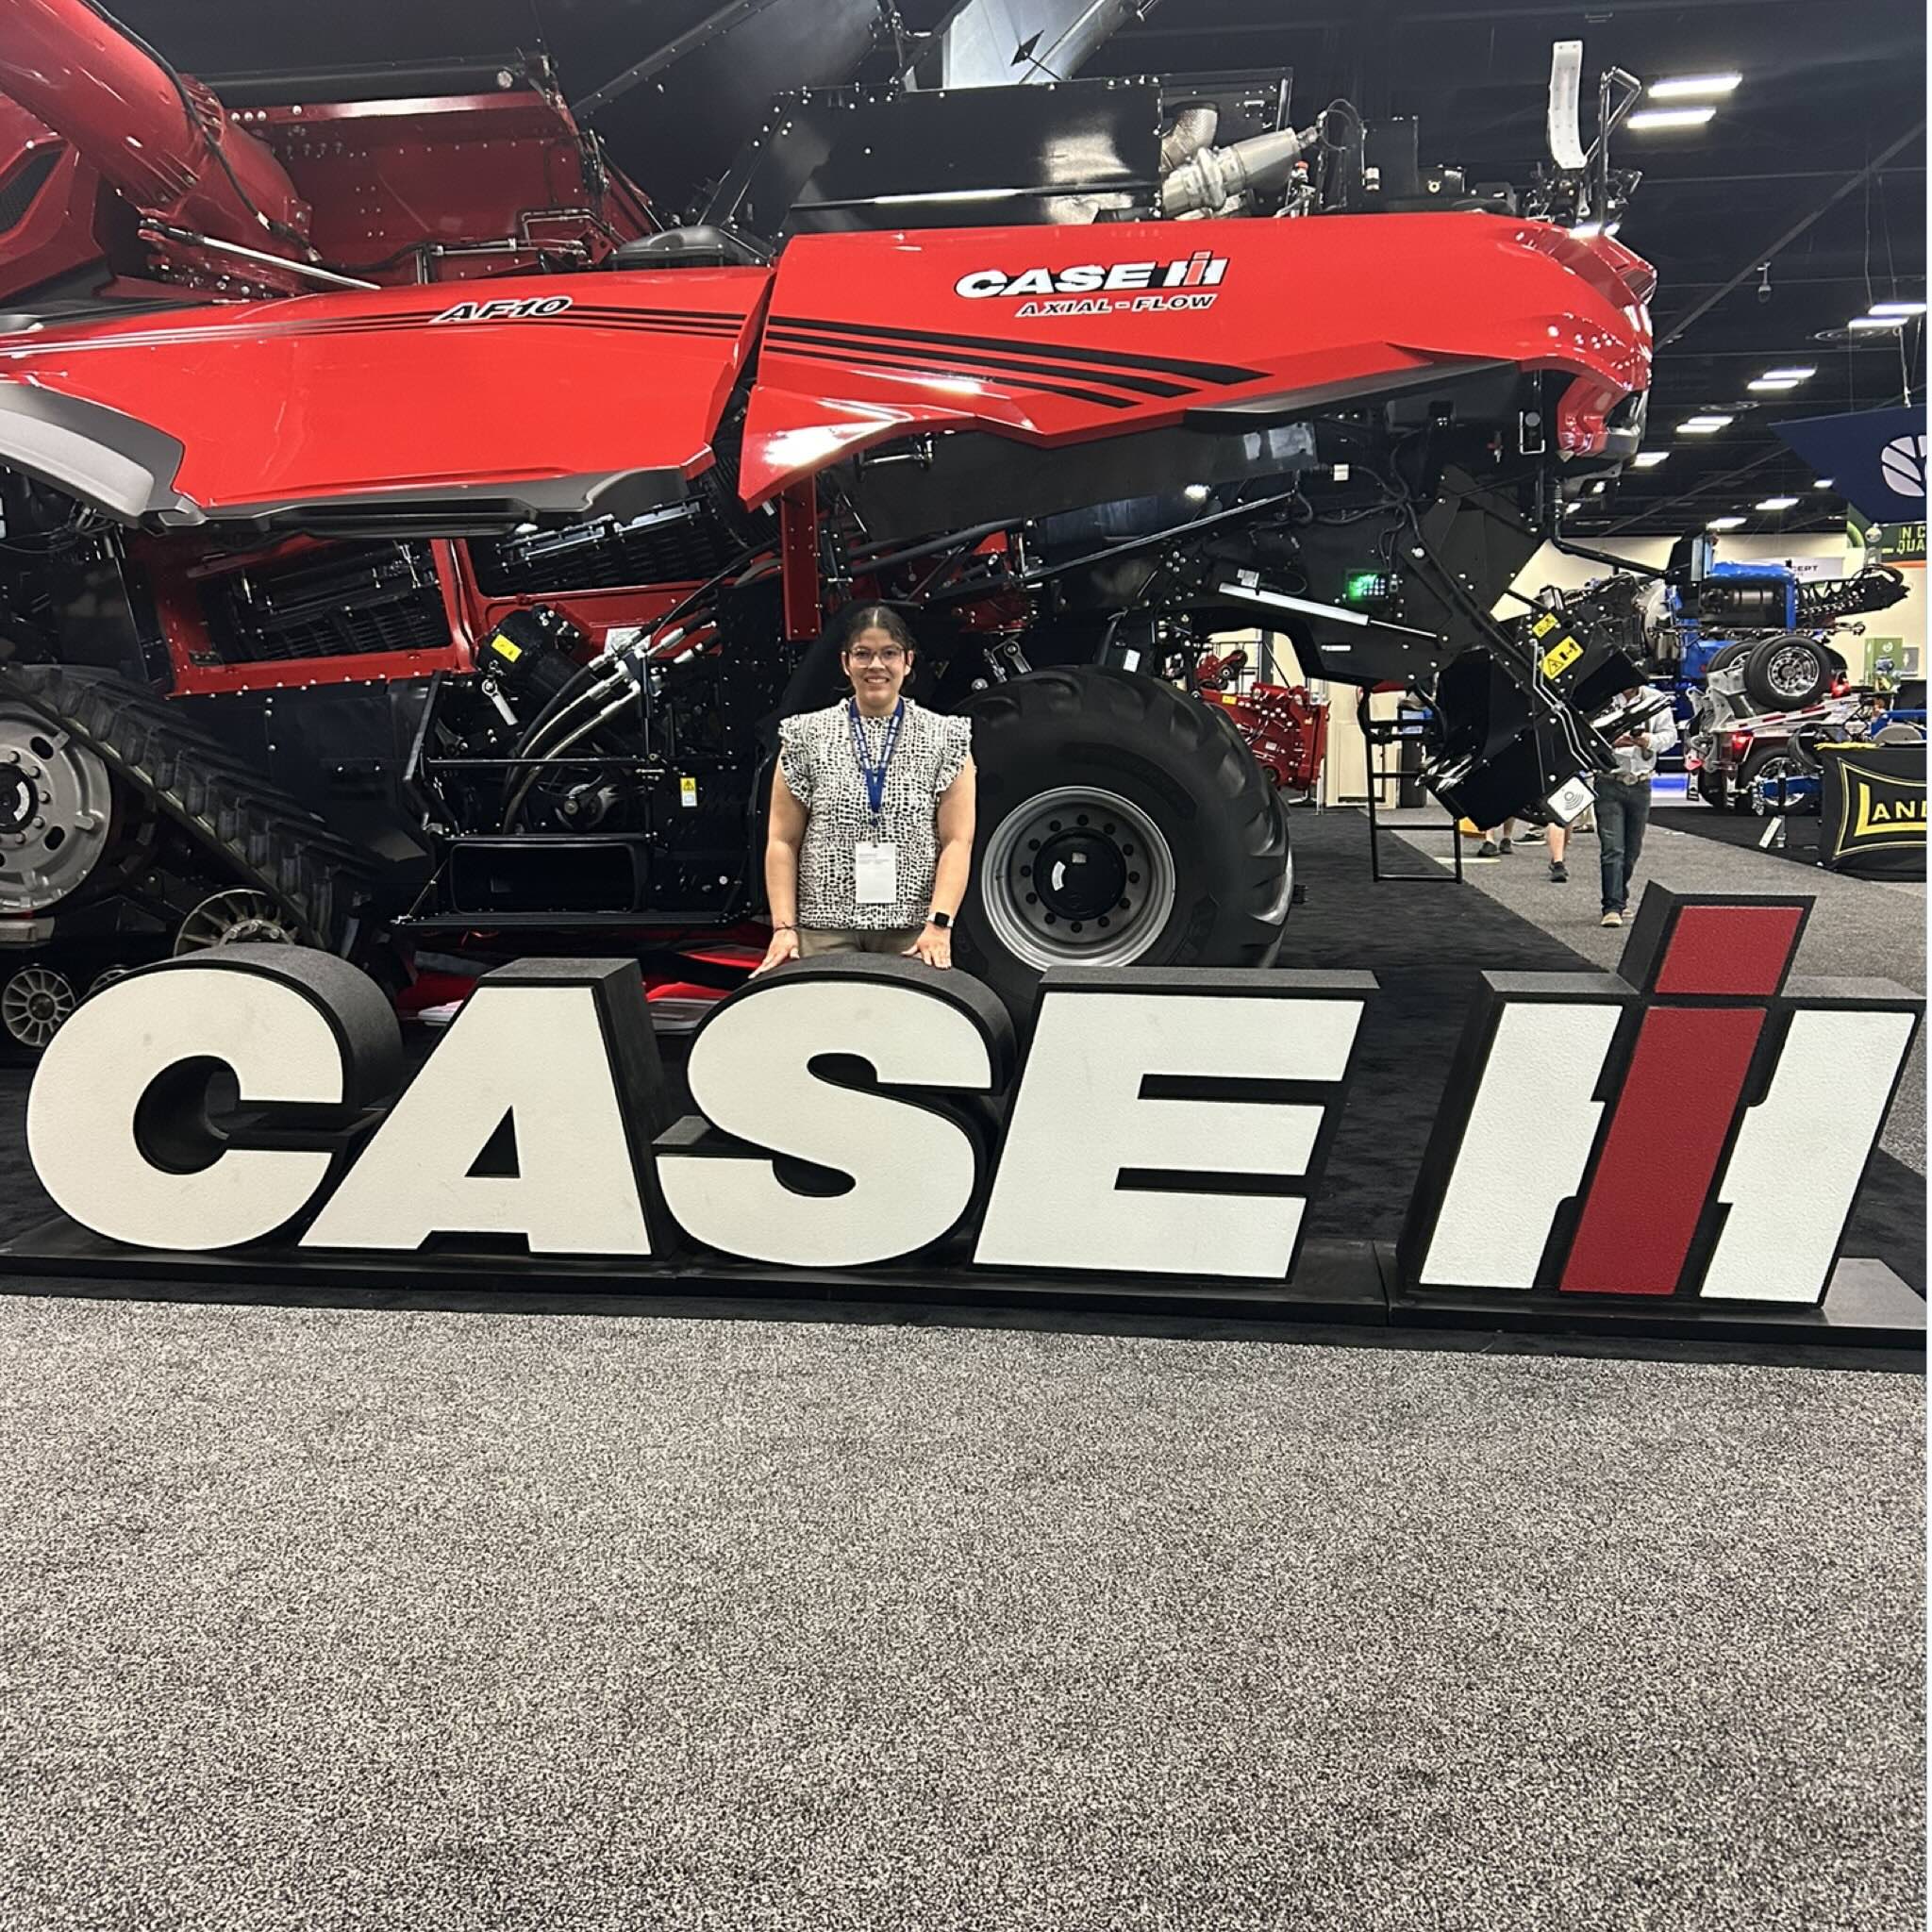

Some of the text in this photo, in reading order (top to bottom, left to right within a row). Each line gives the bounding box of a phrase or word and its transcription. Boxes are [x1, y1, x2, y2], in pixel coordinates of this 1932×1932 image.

[956, 261, 1156, 298] CASE
[430, 296, 572, 323] AF10
[26, 968, 1365, 1279] CASE
